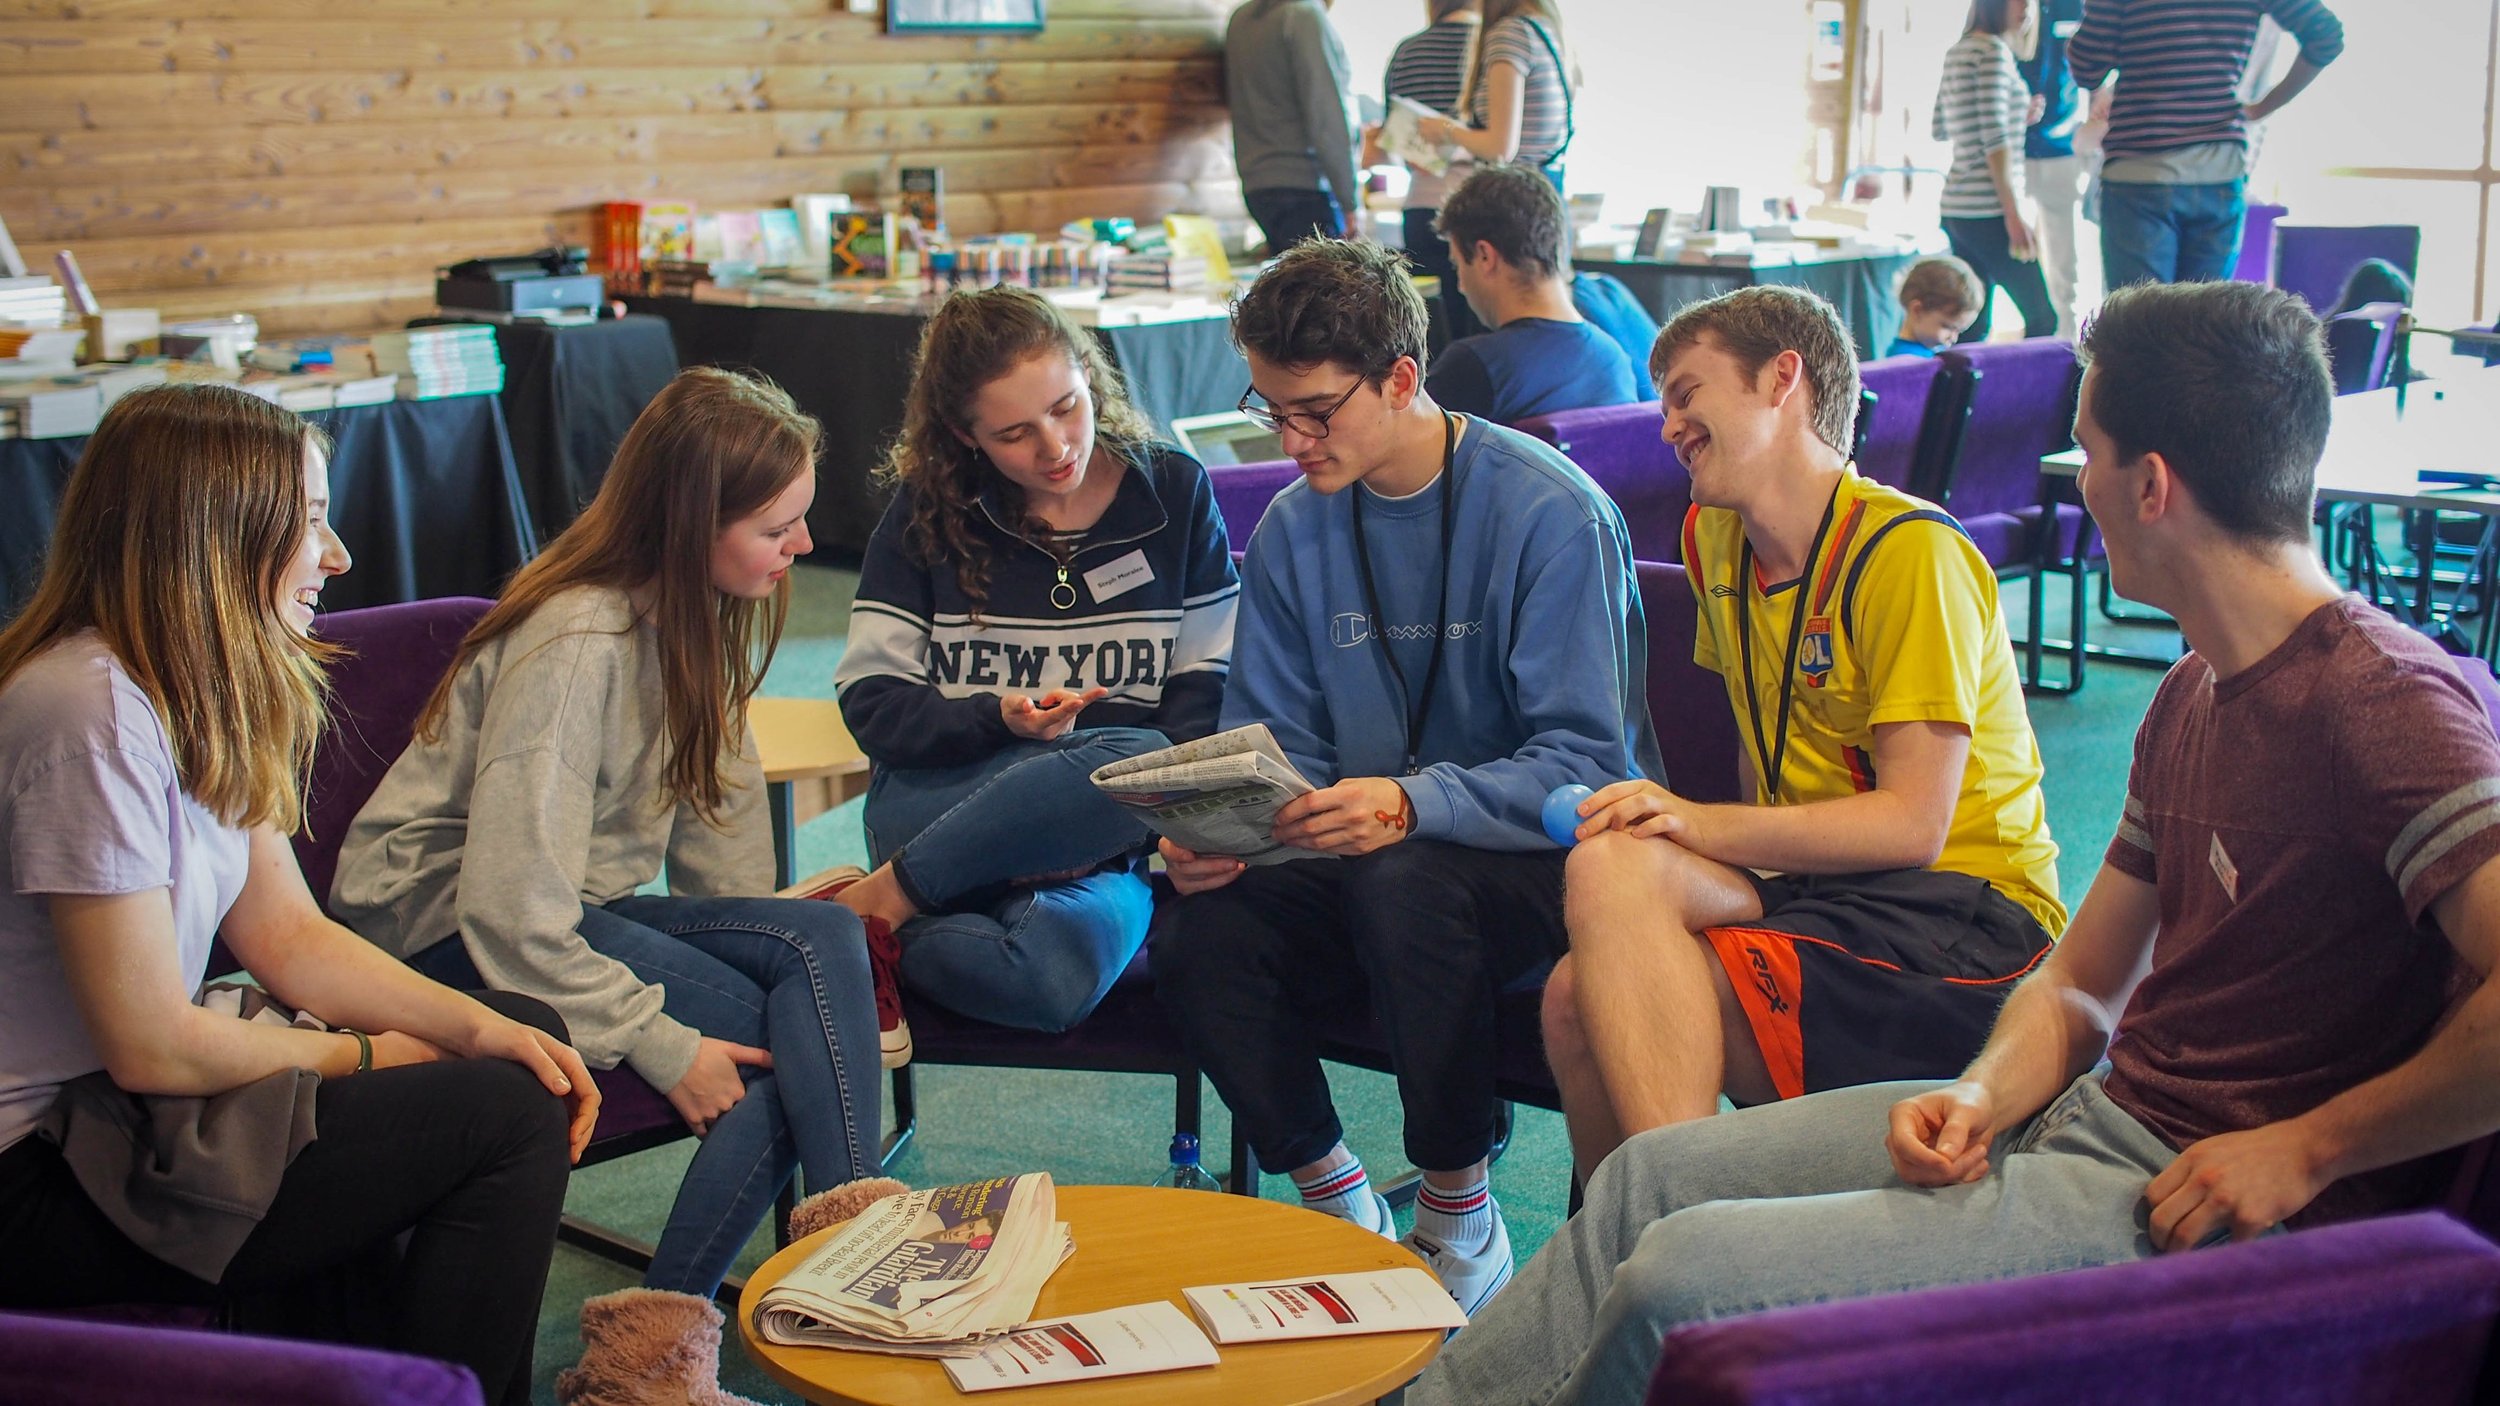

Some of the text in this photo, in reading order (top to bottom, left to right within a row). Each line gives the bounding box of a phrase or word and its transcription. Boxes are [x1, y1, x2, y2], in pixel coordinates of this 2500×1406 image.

[929, 640, 1049, 688] NEW
[867, 1217, 897, 1233] head
[885, 1211, 902, 1219] to
[898, 1203, 925, 1227] faces
[831, 1237, 865, 1260] no-deal
[809, 1257, 842, 1276] Brexit
[845, 1241, 935, 1300] Guardian
[898, 1258, 947, 1282] The
